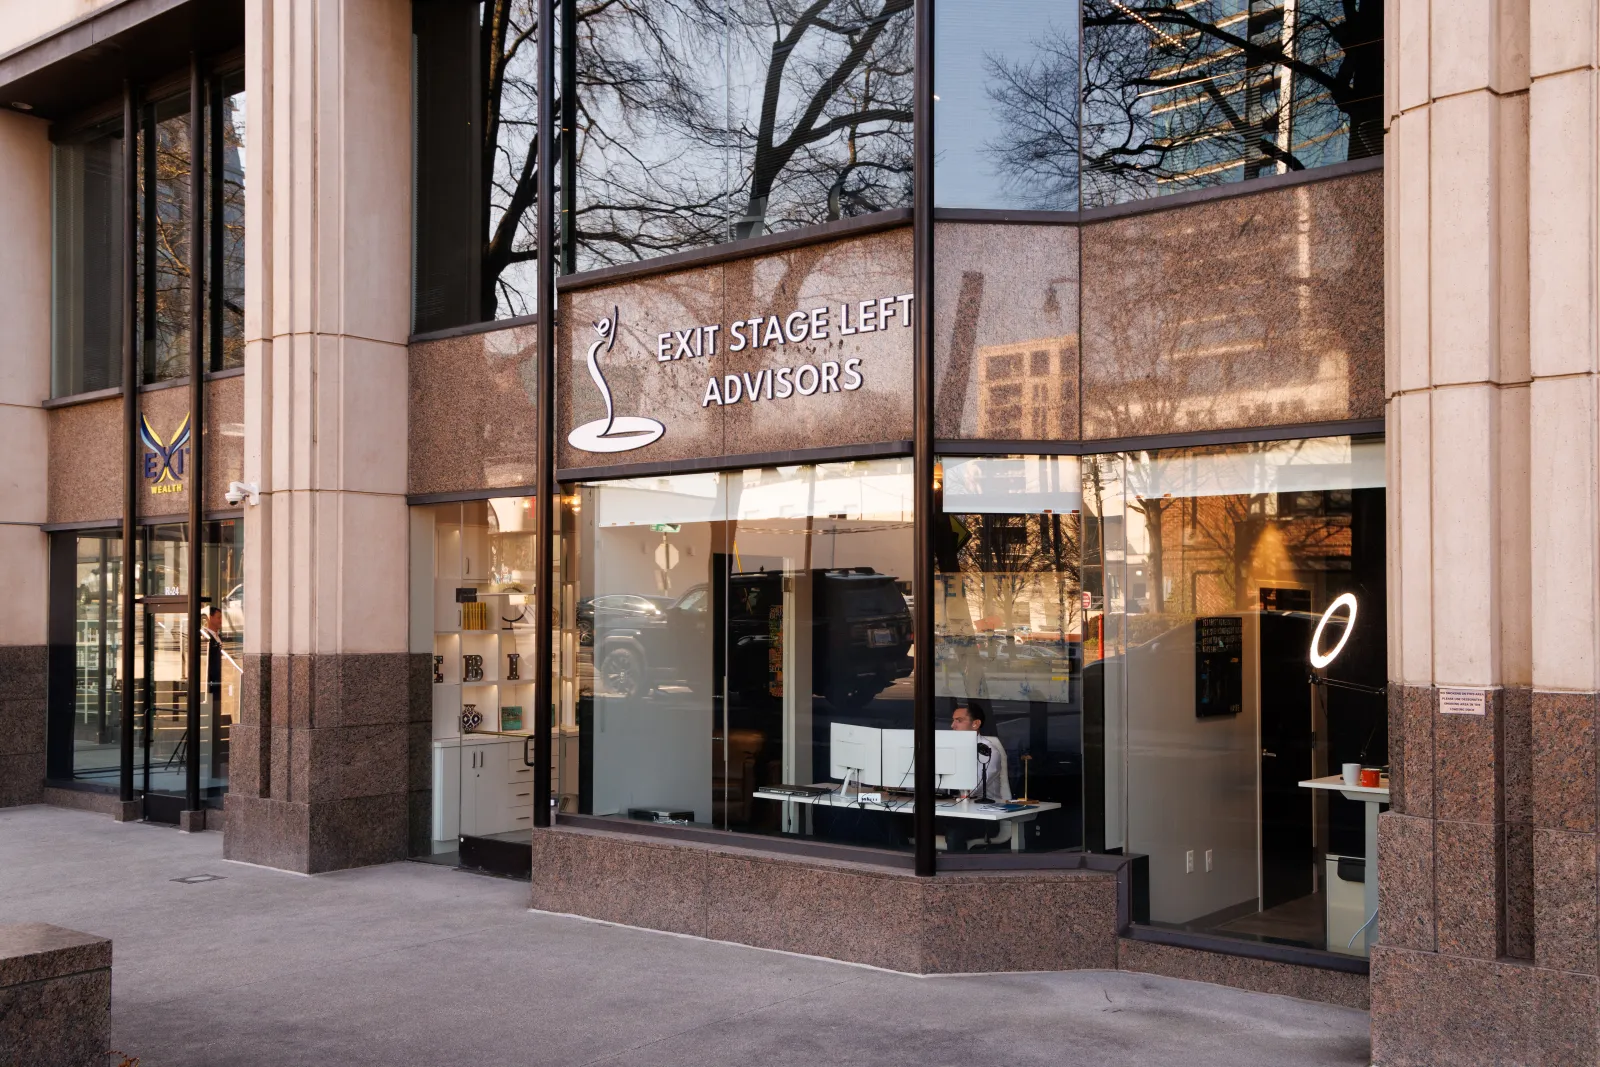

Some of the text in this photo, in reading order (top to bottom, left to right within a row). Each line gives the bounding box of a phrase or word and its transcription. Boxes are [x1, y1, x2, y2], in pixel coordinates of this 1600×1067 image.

[657, 293, 914, 362] EXIT STAGE LEFT
[702, 357, 864, 408] ADVISORS
[151, 483, 183, 495] WEALTH
[165, 586, 179, 596] R-24
